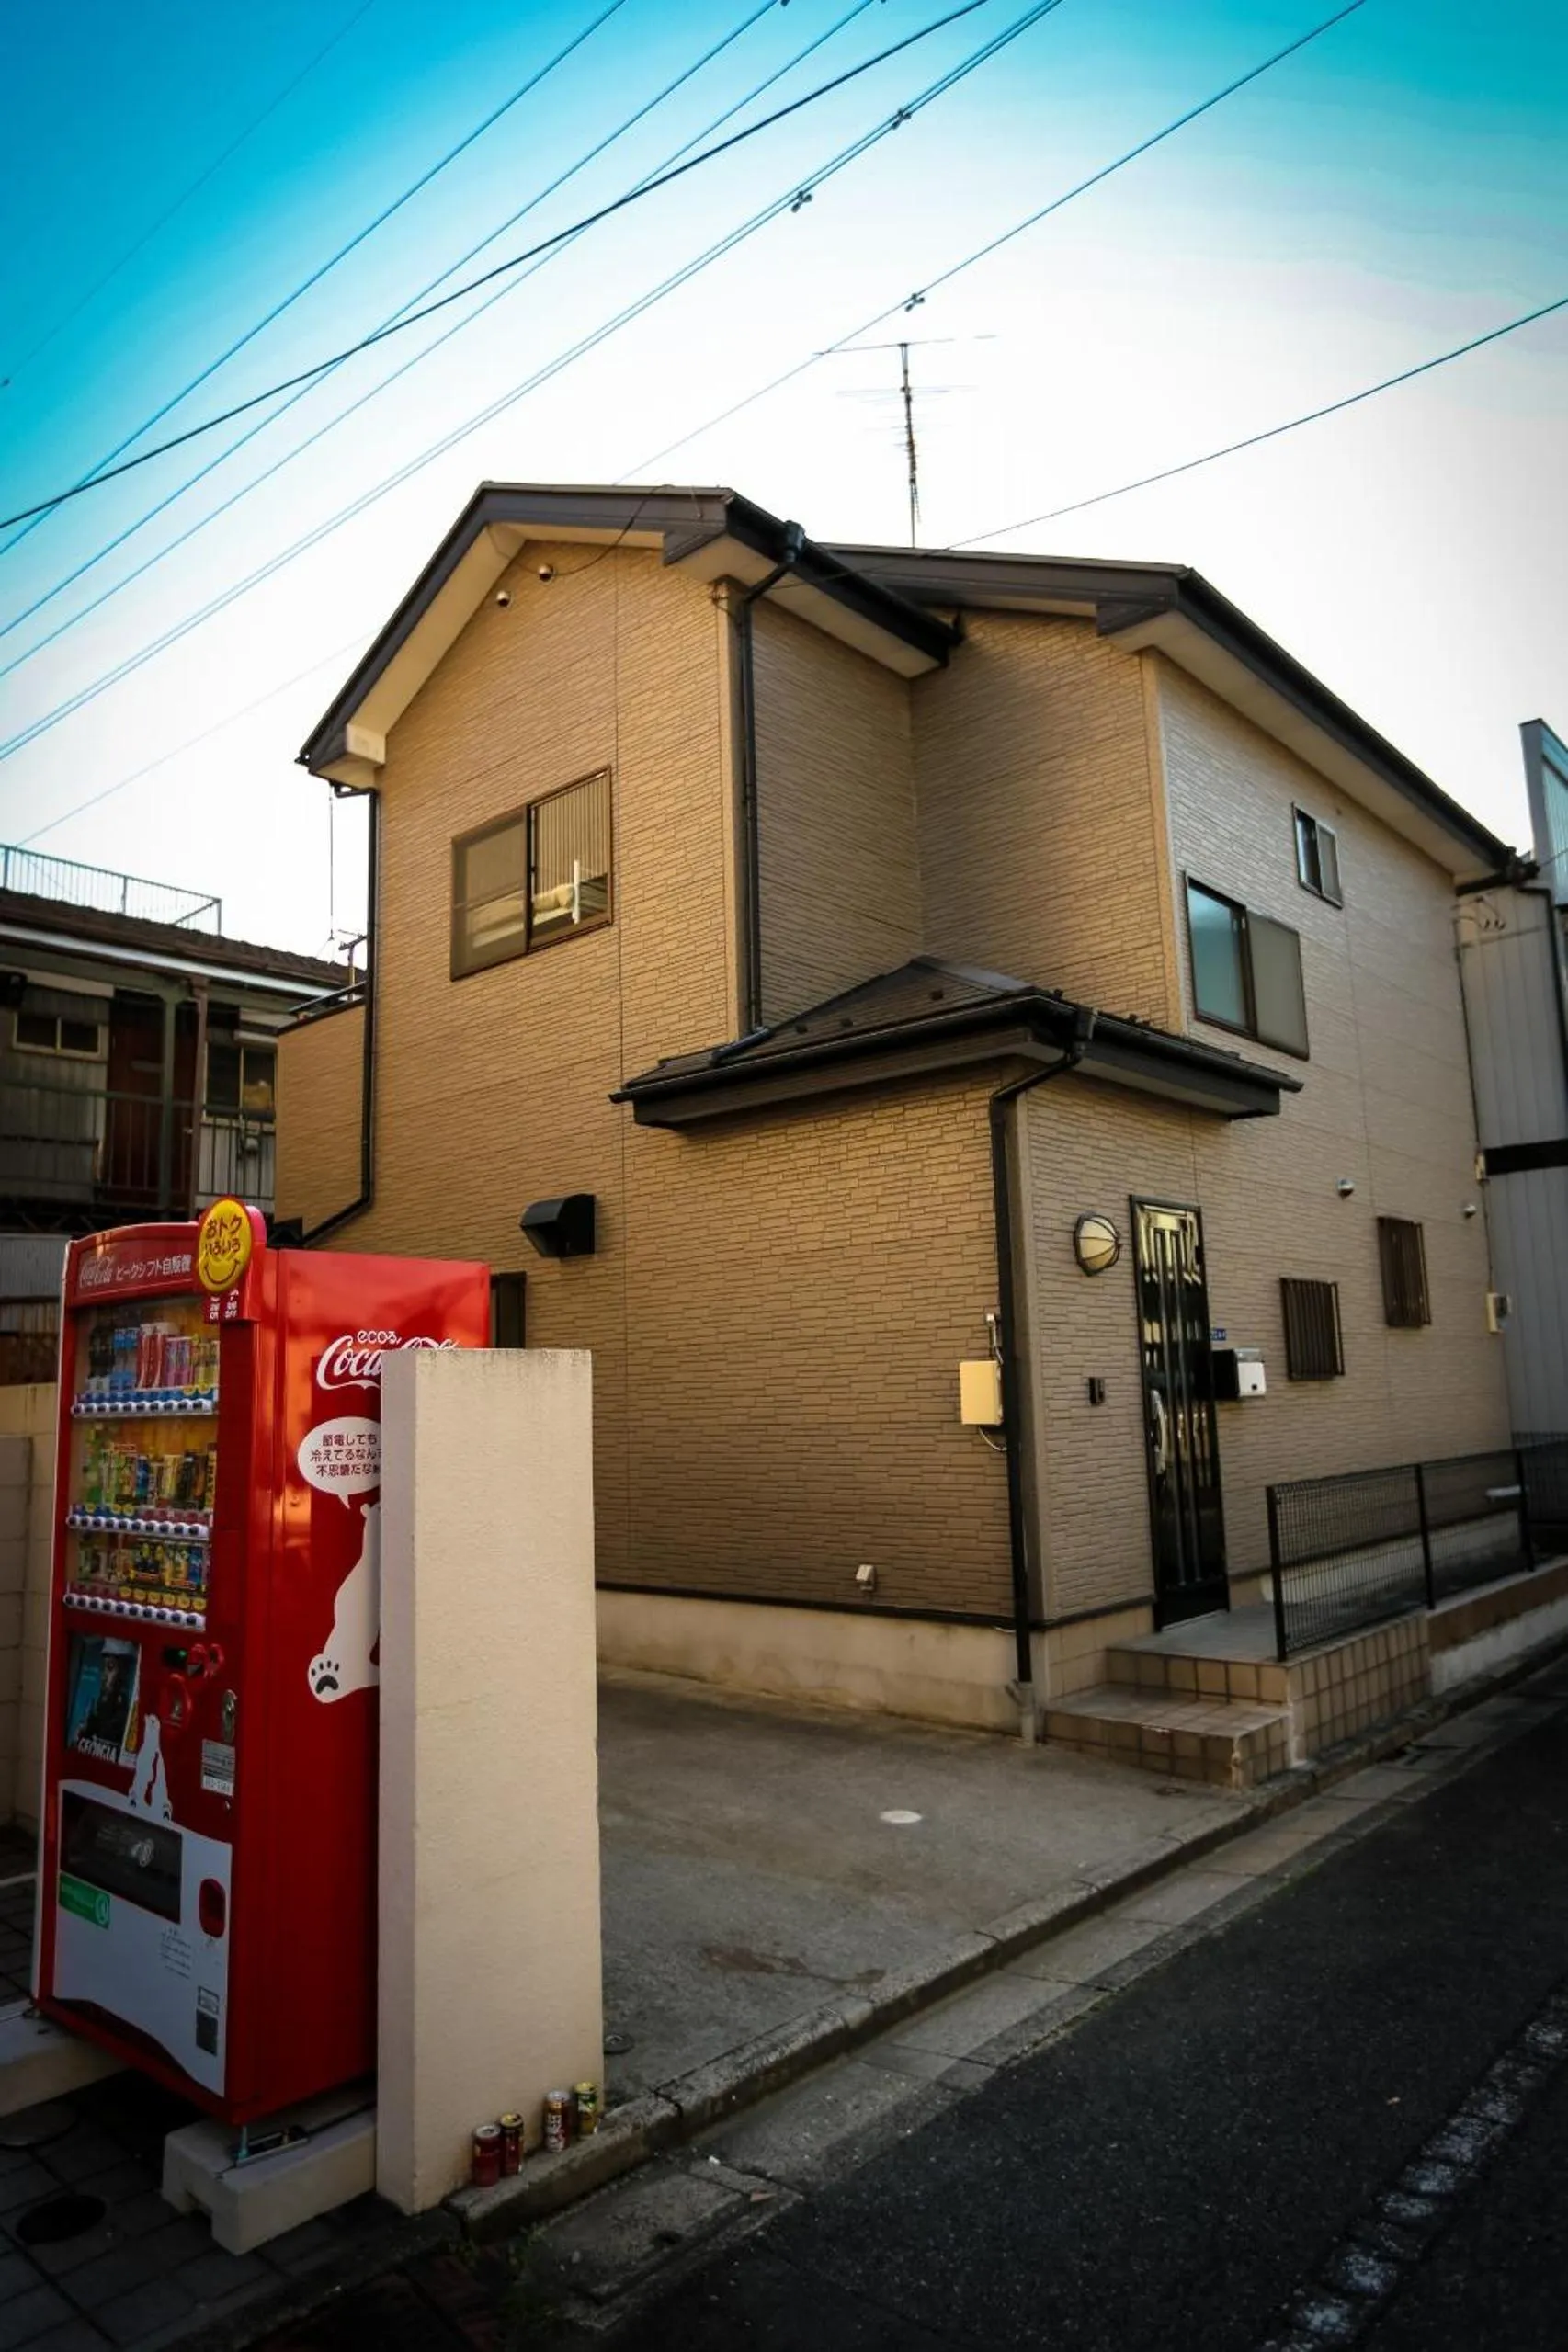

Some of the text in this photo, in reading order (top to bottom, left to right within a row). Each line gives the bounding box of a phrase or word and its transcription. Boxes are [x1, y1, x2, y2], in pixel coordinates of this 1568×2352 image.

[206, 1214, 242, 1239] おトク
[204, 1237, 240, 1256] いろいろ
[323, 1434, 378, 1447] 節電しても
